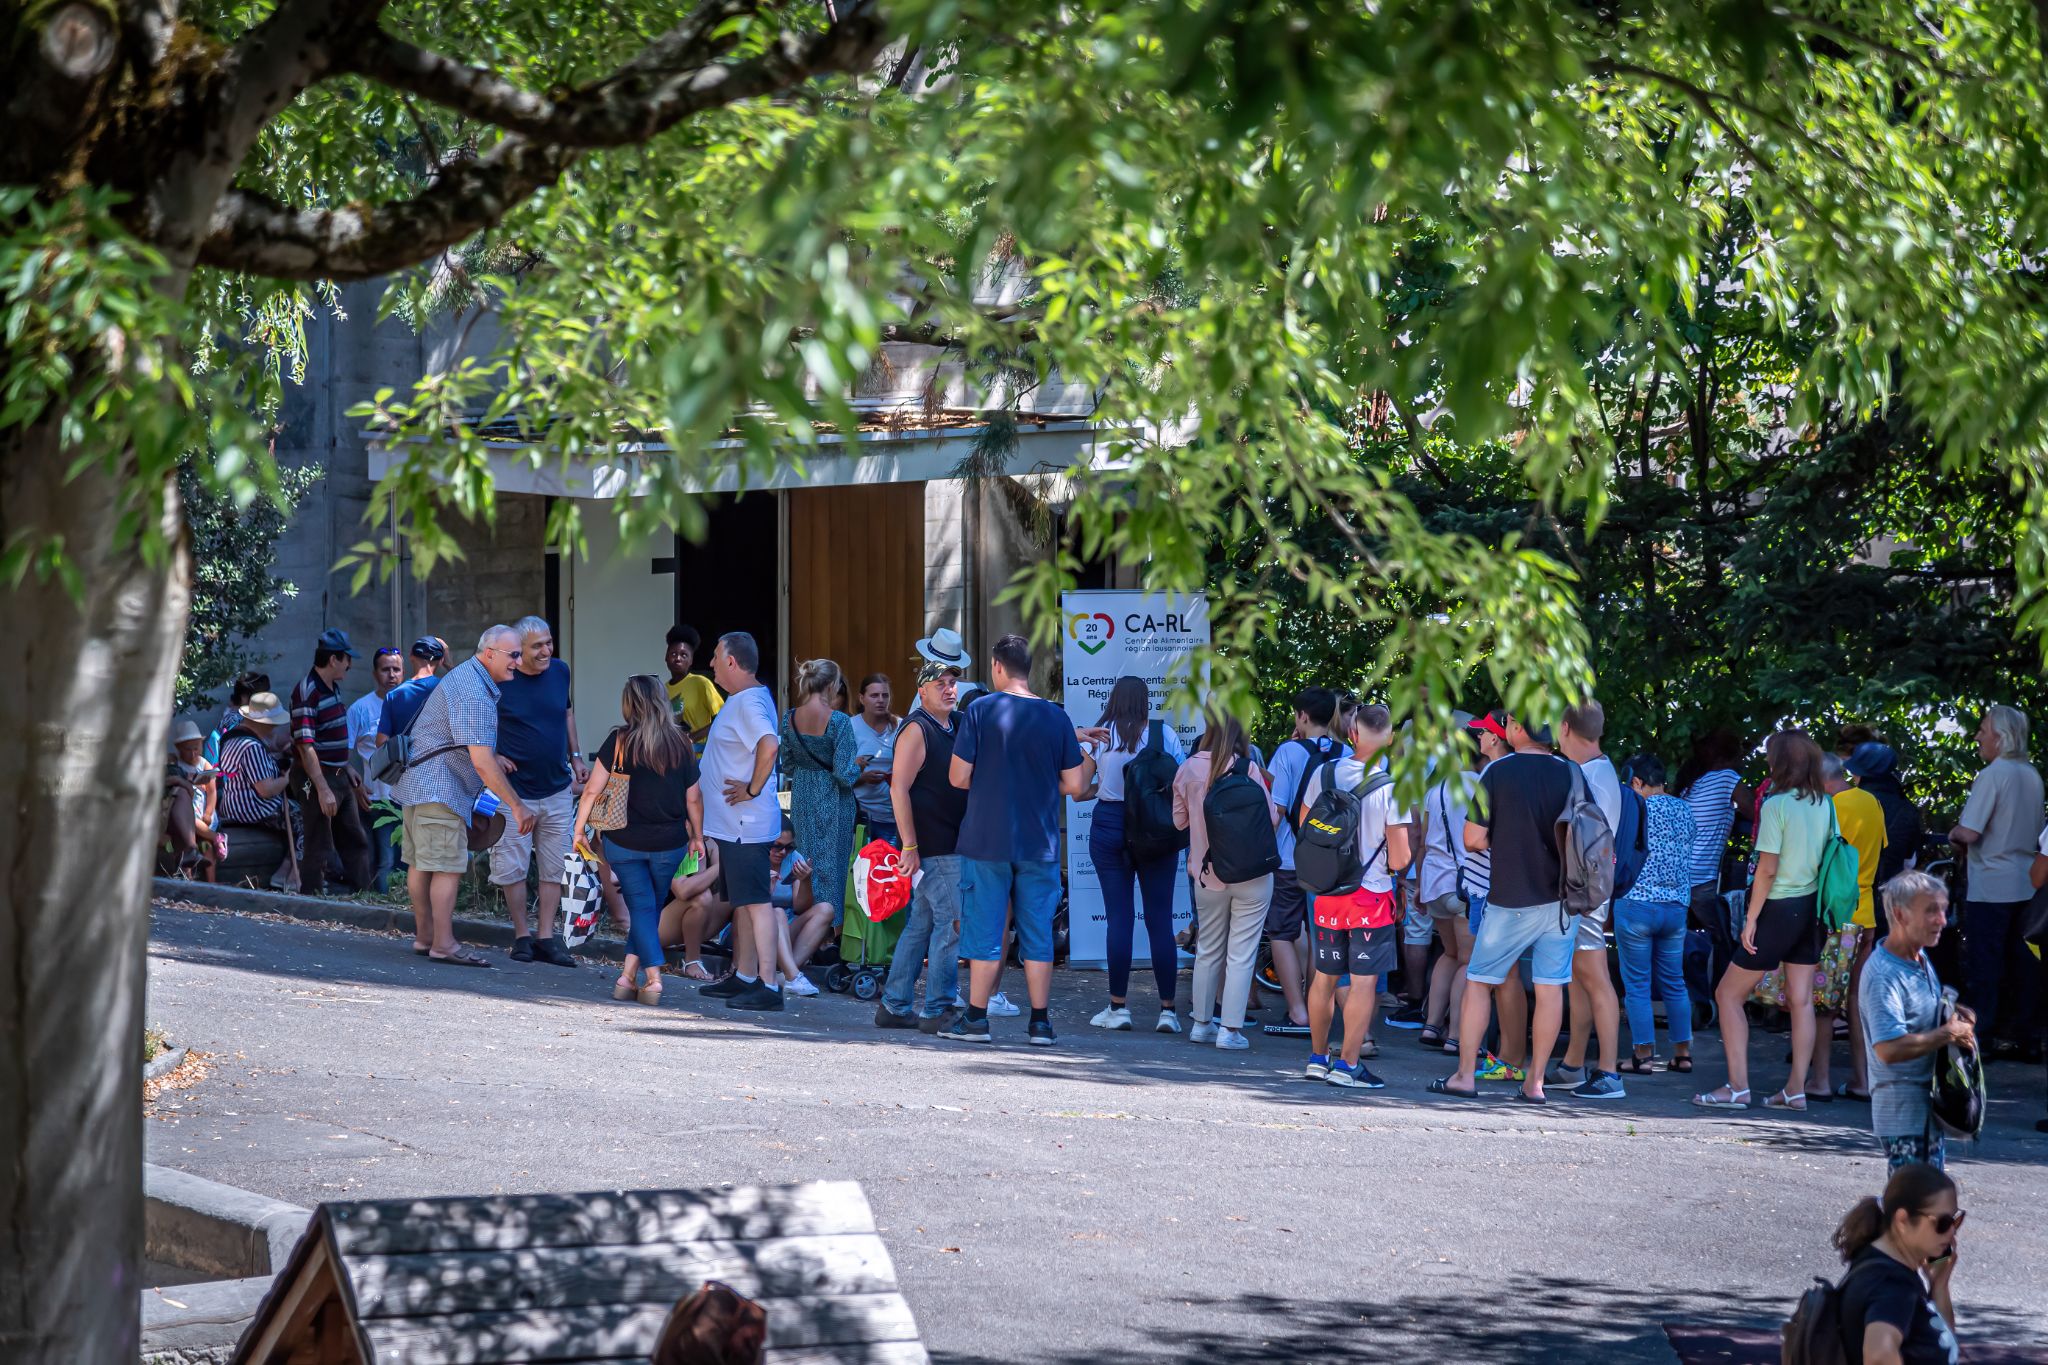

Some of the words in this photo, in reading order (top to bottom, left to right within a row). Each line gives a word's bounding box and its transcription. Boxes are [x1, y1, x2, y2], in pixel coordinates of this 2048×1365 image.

[1085, 623, 1098, 632] 20
[1124, 613, 1191, 633] CA-RL
[1125, 637, 1159, 645] Centrale
[1160, 637, 1204, 645] Alimentaire
[1125, 645, 1151, 653] région
[1067, 676, 1079, 686] La
[1081, 676, 1117, 686] Central
